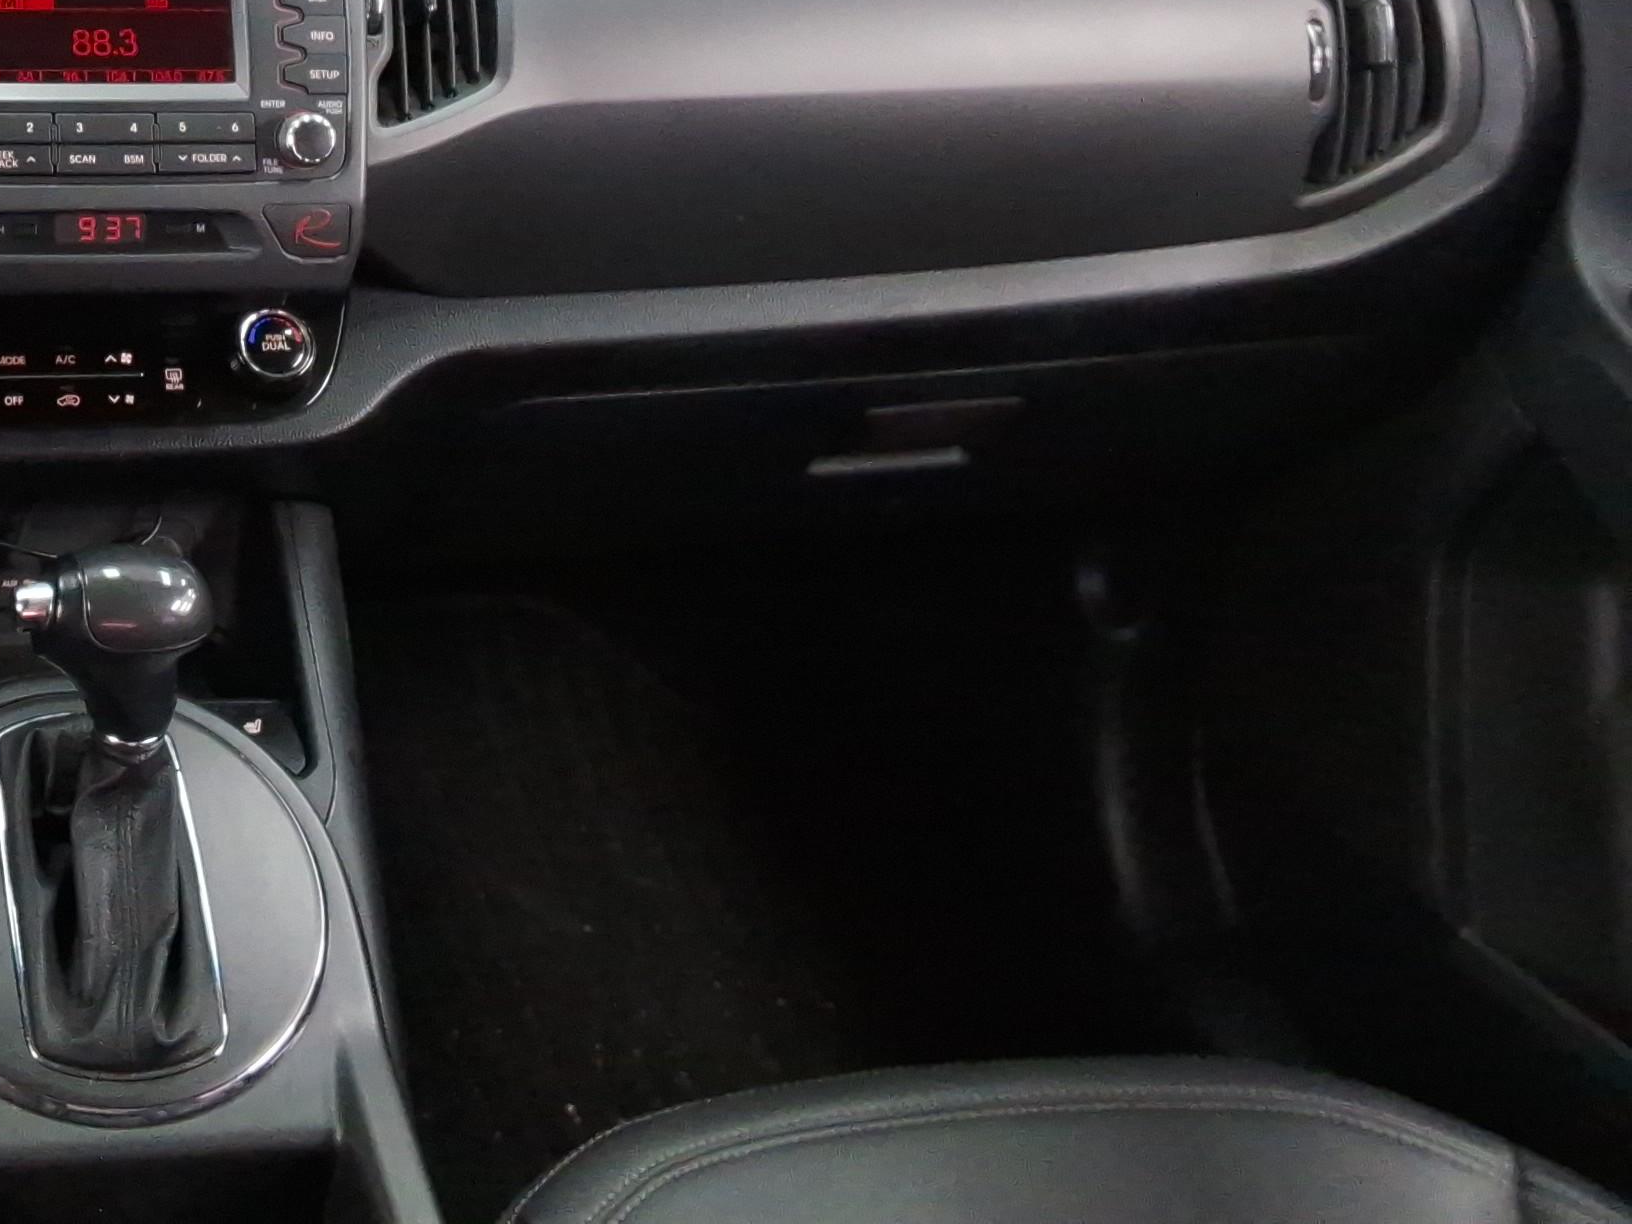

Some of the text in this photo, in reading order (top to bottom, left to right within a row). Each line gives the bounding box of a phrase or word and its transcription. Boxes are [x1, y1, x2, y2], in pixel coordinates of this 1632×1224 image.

[310, 32, 335, 41] INFO
[72, 28, 139, 56] 88.3
[309, 69, 340, 79] SETUP
[261, 100, 286, 108] ENTER
[318, 100, 343, 109] AUDIO
[26, 122, 34, 133] 2
[76, 122, 83, 133] 3
[130, 122, 137, 133] 4
[179, 122, 186, 133] 5
[231, 122, 239, 133] 6
[69, 154, 96, 164] SCAN
[124, 155, 144, 164] BSM
[192, 153, 227, 163] FOLDER
[262, 342, 291, 351] DUAL
[55, 355, 76, 365] A/C
[165, 383, 184, 391] REAR
[4, 396, 24, 406] OFF
